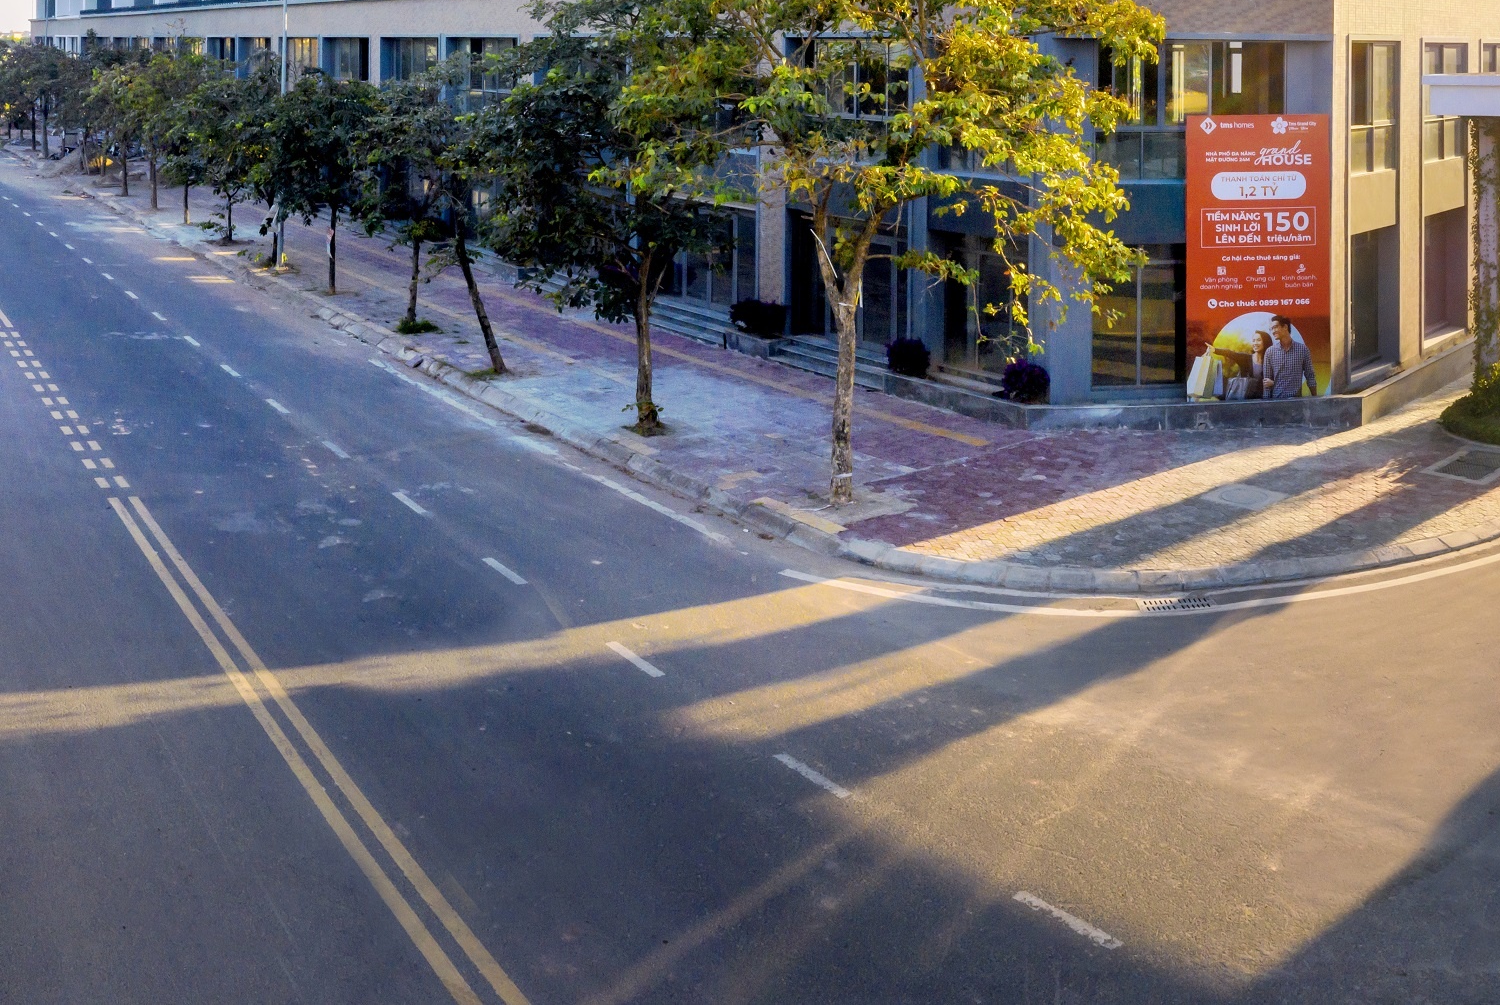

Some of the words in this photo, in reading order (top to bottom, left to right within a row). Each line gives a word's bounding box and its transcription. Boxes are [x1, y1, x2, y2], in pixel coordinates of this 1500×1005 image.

[1233, 121, 1255, 129] homes
[1254, 139, 1302, 166] grand
[1261, 154, 1312, 166] HOUSE
[1250, 174, 1270, 182] TOÁN
[1239, 185, 1257, 198] 1,2
[1261, 182, 1279, 197] TỶ
[1231, 210, 1261, 221] NĂNG
[1263, 211, 1310, 232] 150
[1215, 223, 1241, 233] SINH
[1215, 233, 1236, 244] LÊN
[1238, 232, 1261, 243] ĐẾN
[1266, 233, 1312, 244] triệu/năm
[1218, 300, 1235, 308] Cho
[1236, 299, 1258, 307] thuê:
[1259, 299, 1279, 307] 0899
[1280, 298, 1294, 306] 167
